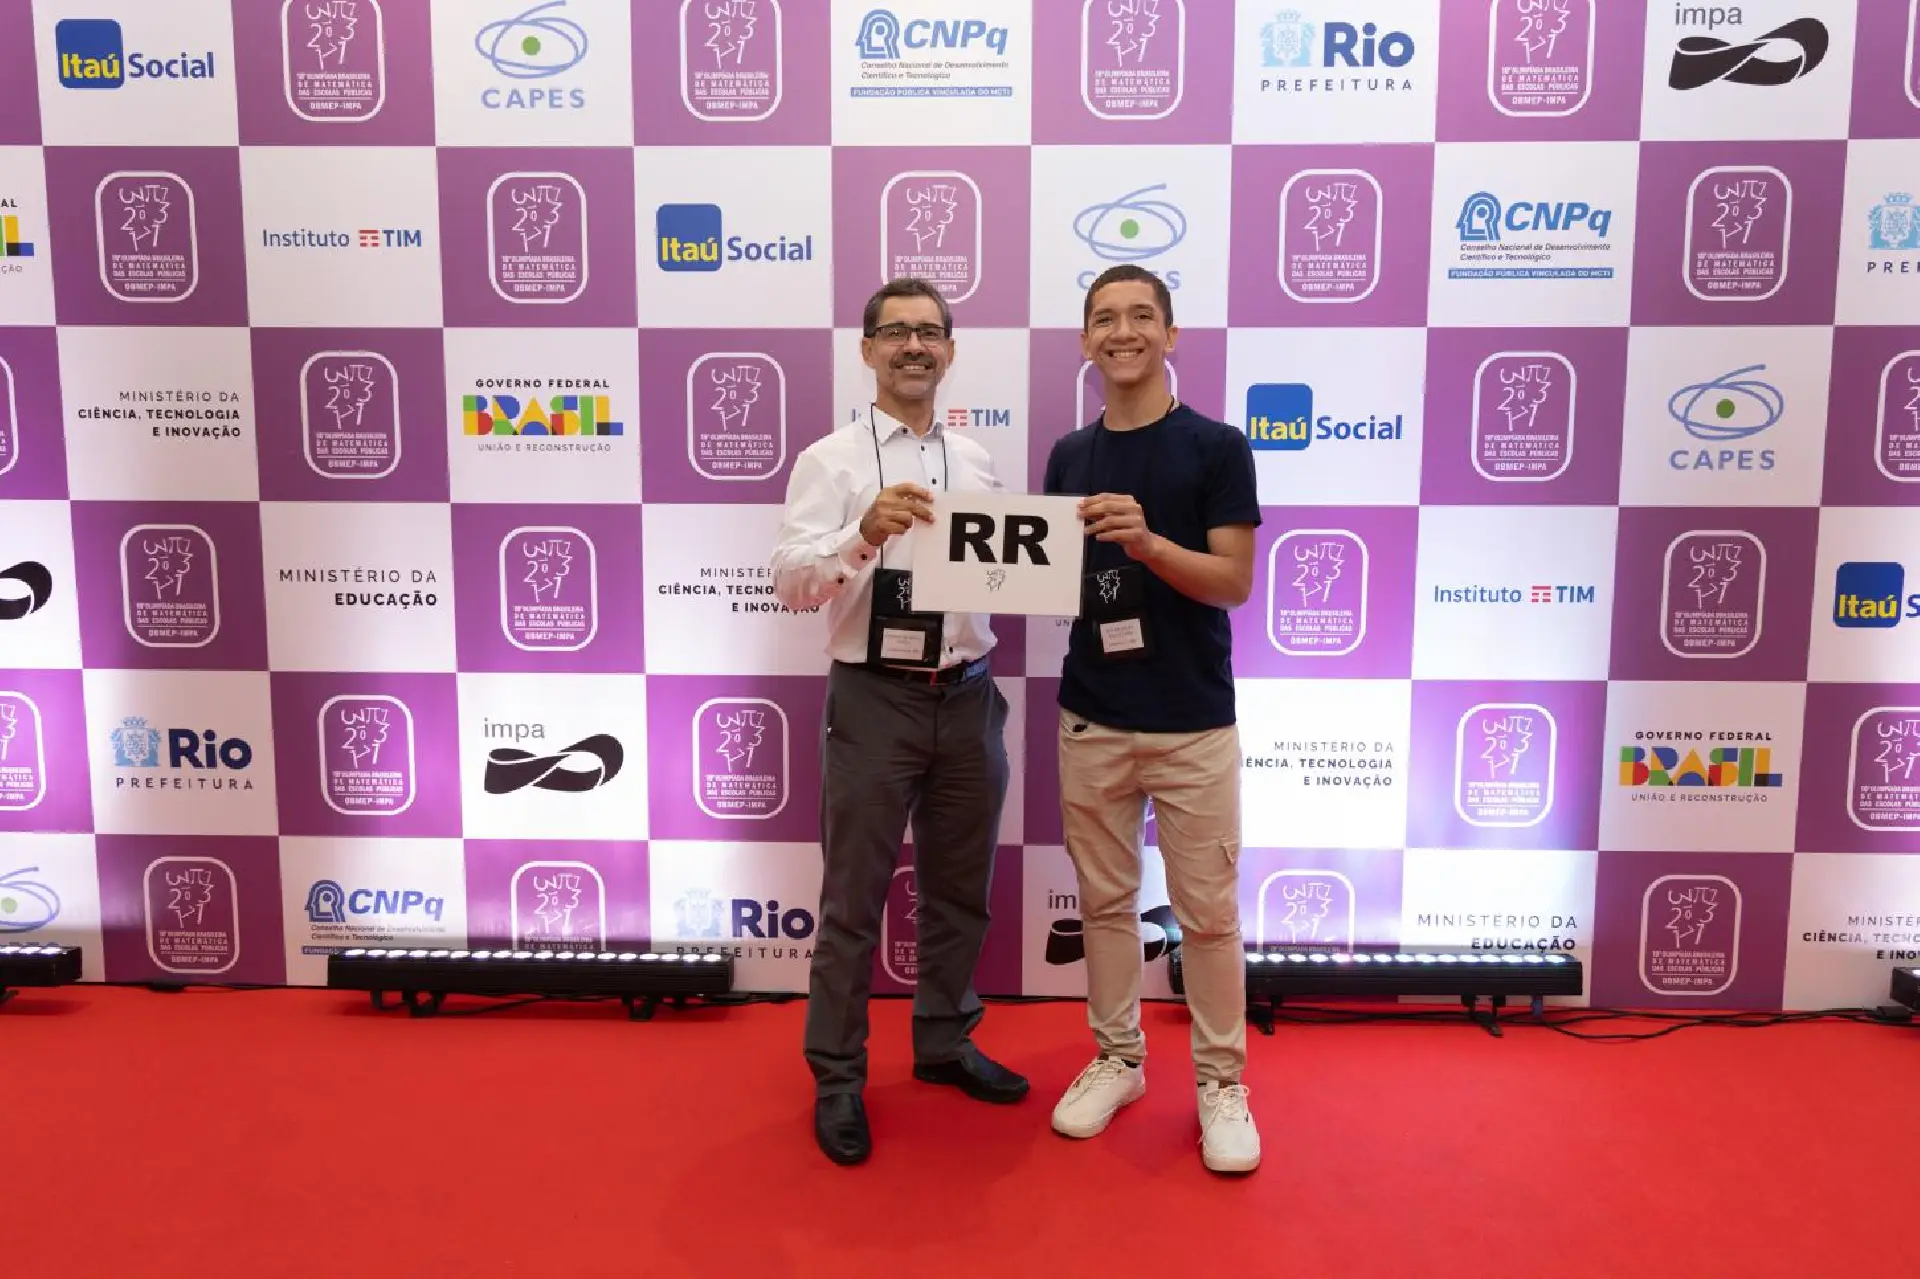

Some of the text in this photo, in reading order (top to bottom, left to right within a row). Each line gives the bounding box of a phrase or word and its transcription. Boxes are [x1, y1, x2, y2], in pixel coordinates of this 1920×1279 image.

[1676, 2, 1742, 29] impa
[903, 20, 1008, 55] CNPq
[1324, 22, 1415, 67] Rio
[62, 52, 214, 79] Itaú Social
[899, 61, 930, 69] Nacional
[933, 61, 942, 69] de
[906, 71, 950, 81] Tecnológico
[1261, 79, 1411, 92] PREFEITURA
[481, 88, 585, 109] CAPES
[1506, 202, 1611, 238] CNPq
[263, 229, 421, 247] Instituto TIM
[661, 235, 811, 262] Itaú Social
[1499, 243, 1532, 251] Nacional
[1534, 243, 1543, 251] de
[1505, 253, 1551, 262] Tecnológico
[476, 379, 609, 387] GOVERNO FEDERAL
[120, 390, 239, 402] MINISTÉRIO DA
[78, 407, 239, 419] CIÊNCIA, TECNOLOGIA
[463, 395, 623, 435] BRASIL
[971, 409, 1010, 426] TIM
[153, 425, 240, 439] E INOVAÇÃO
[1246, 415, 1402, 440] Itaú Social
[478, 443, 511, 451] UNIÃO
[527, 443, 610, 454] RECONSTRUÇÃO
[1669, 449, 1774, 470] CAPES
[949, 512, 1050, 565] RR
[280, 566, 436, 582] MINISTÉRIO DA
[701, 566, 771, 578] MINISTÉ
[659, 582, 774, 595] CIÊNCIA, TECNO
[1435, 585, 1594, 603] Instituto TIM
[335, 590, 436, 609] EDUCAÇÃO
[732, 602, 738, 611] E
[1839, 594, 1897, 618] Itaú
[484, 718, 545, 742] impa
[1636, 732, 1771, 740] GOVERNO FEDERAL
[168, 729, 252, 770] Rio
[1374, 742, 1393, 752] DA
[1246, 756, 1392, 769] ÊNCIA, TECNOLOGIA
[1619, 746, 1782, 787] BRASIL
[116, 778, 252, 789] PREFEITURA
[1304, 774, 1392, 788] E INOVAÇÃO
[1632, 793, 1665, 801] UNIÃO
[1680, 793, 1767, 803] RECONSTRUÇÃO
[349, 889, 444, 922] CNPq
[1048, 889, 1076, 909] im
[732, 899, 814, 940] Rio
[1418, 914, 1577, 928] MINISTÉRIO DA
[1803, 930, 1867, 942] CIÊNCIA,
[1471, 936, 1575, 955] EDUCAÇÃO
[1876, 950, 1884, 959] E
